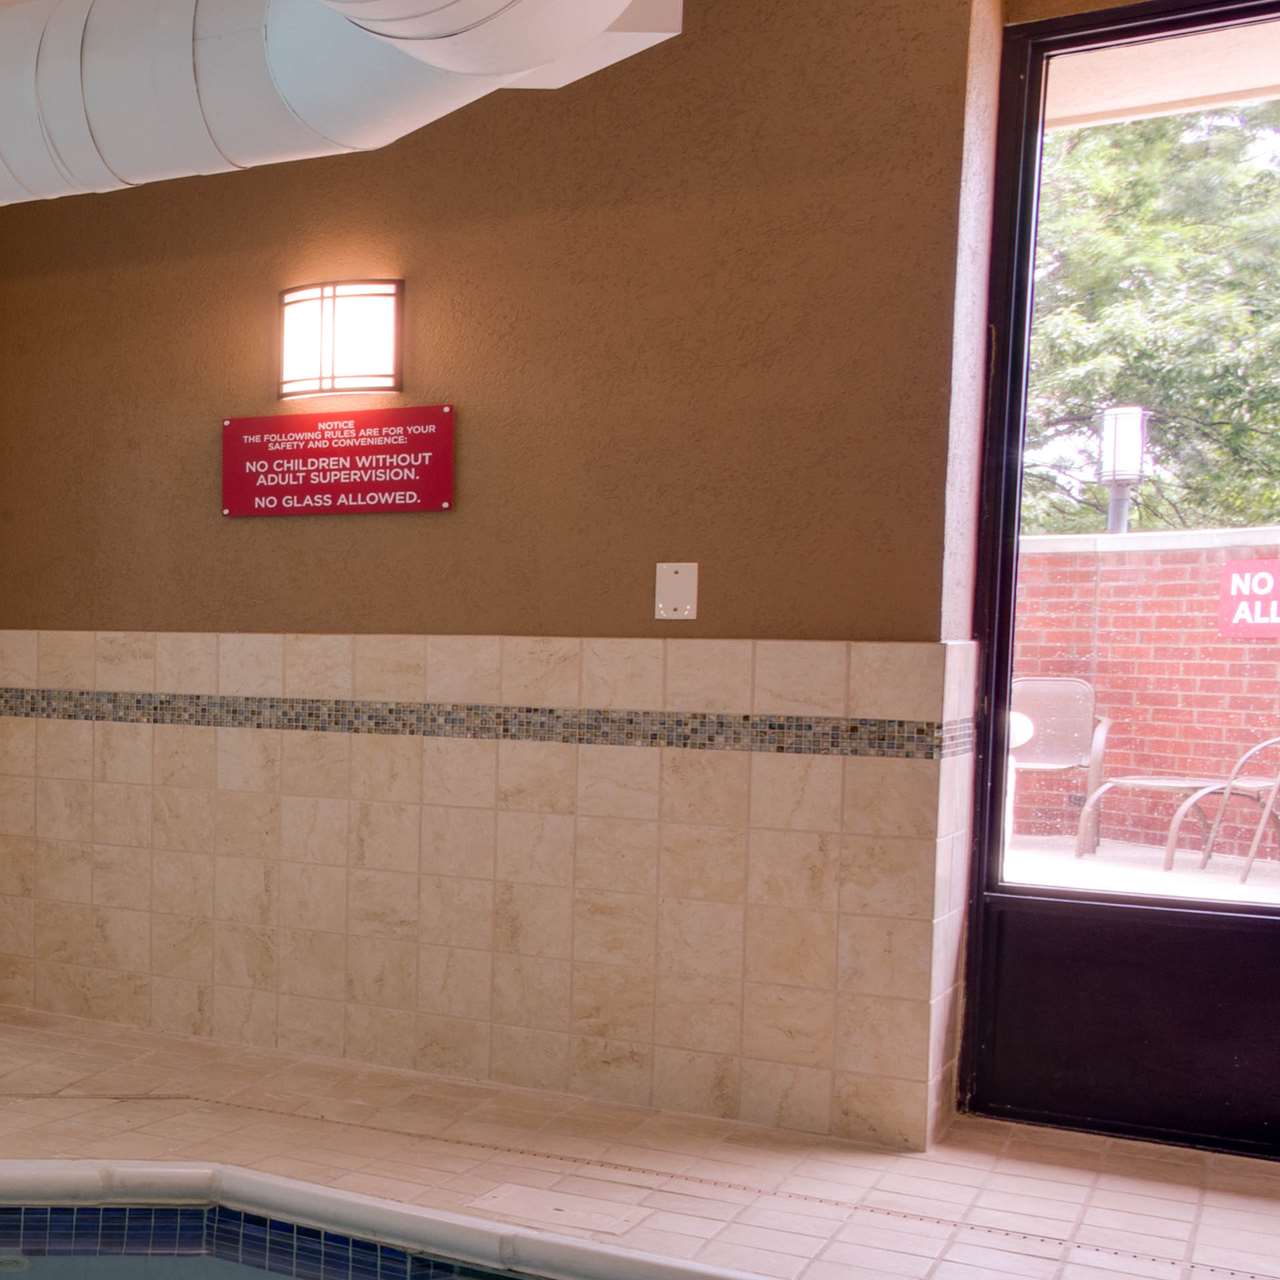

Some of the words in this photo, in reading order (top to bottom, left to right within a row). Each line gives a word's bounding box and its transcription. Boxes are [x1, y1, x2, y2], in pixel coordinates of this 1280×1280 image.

[243, 434, 261, 443] THE
[263, 431, 322, 443] FOLLOWING
[324, 429, 356, 439] RULES
[359, 427, 379, 437] ARE
[382, 426, 403, 435] FOR
[406, 424, 436, 434] YOUR
[318, 420, 355, 430] NOTICE
[268, 440, 304, 451] SAFETY
[308, 439, 329, 449] AND
[332, 435, 408, 447] CONVENIENCE:
[245, 460, 269, 473] NO
[273, 456, 351, 472] CHILDREN
[356, 452, 433, 468] WITHOUT
[256, 472, 306, 486] ADULT
[310, 468, 420, 484] SUPERVISION.
[254, 496, 278, 508] NO
[282, 494, 332, 507] GLASS
[336, 491, 421, 506] ALLOWED.
[1231, 571, 1275, 596] NO
